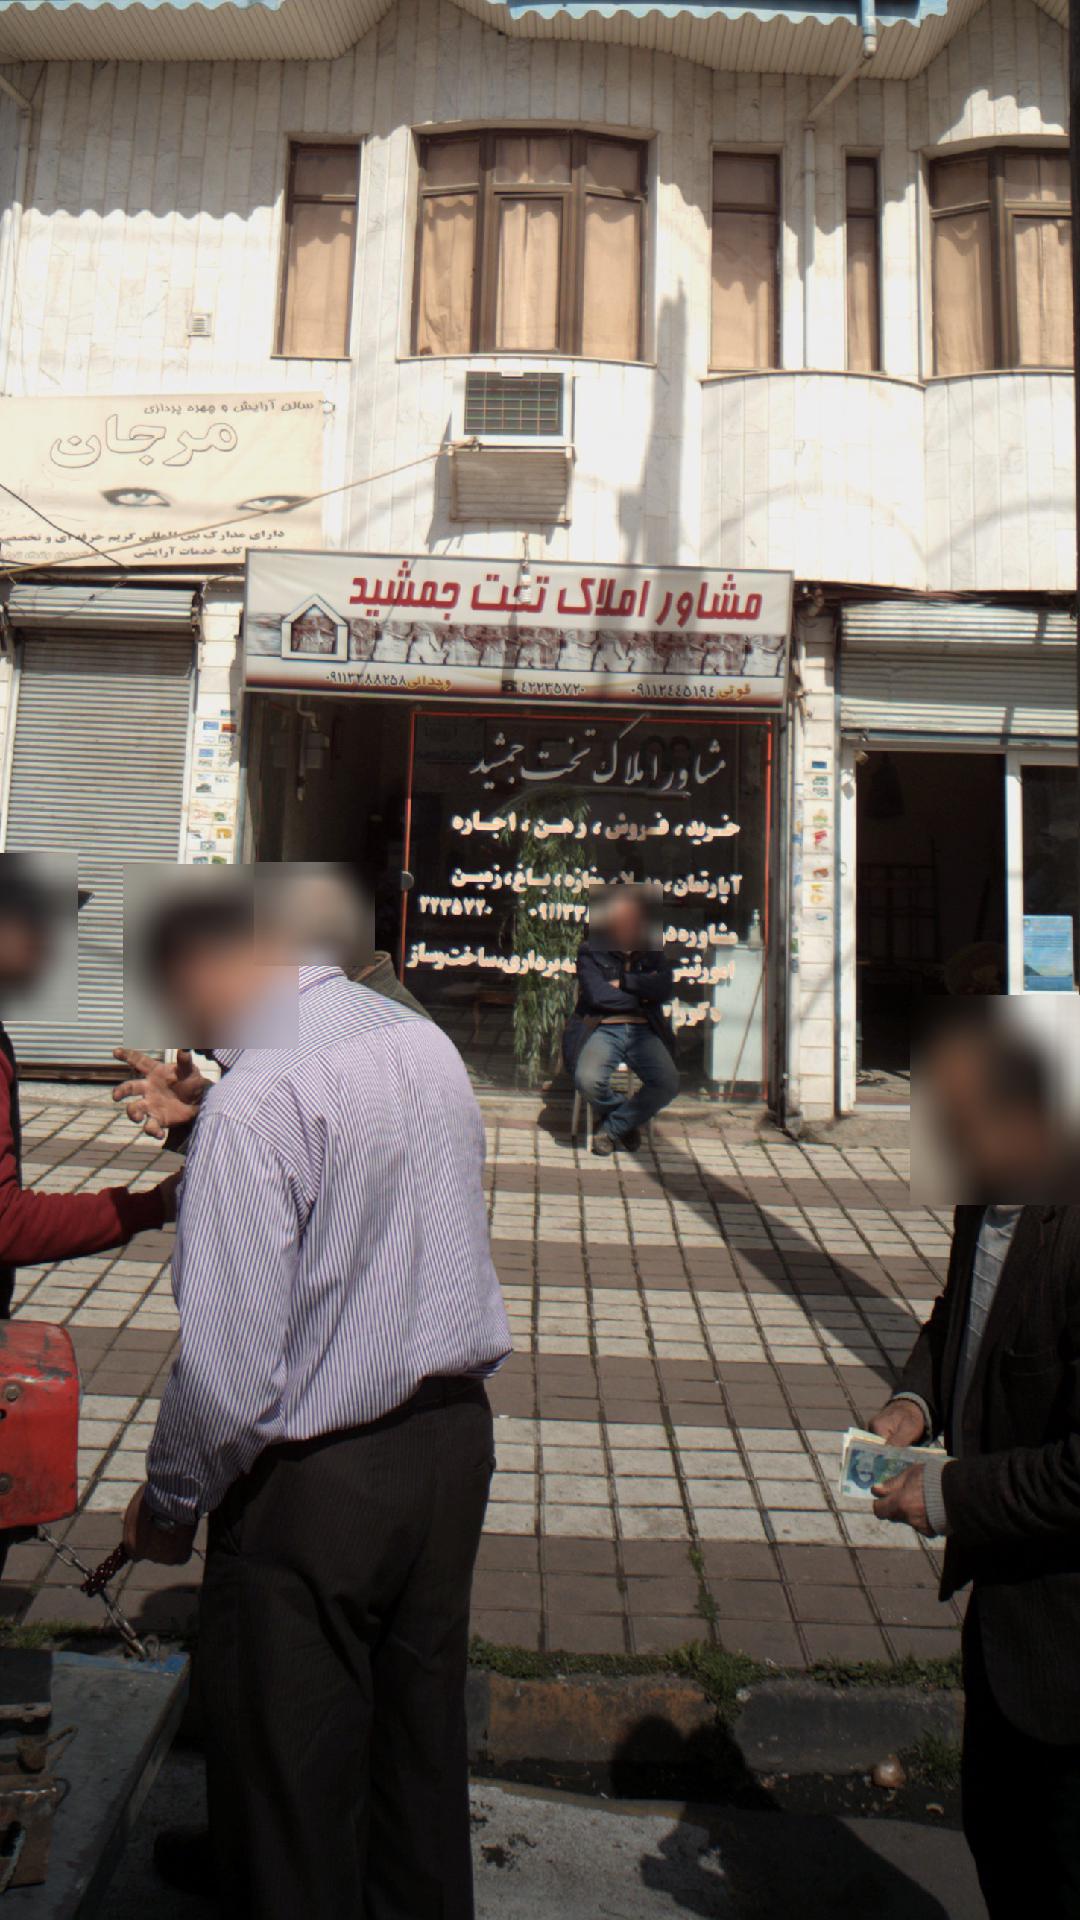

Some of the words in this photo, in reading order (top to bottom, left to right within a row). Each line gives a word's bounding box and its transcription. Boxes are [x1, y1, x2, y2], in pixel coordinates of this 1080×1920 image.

[233, 399, 276, 413] آرایش
[49, 413, 238, 469] مرجان
[179, 546, 218, 556] خدمات
[203, 530, 245, 541] مدارک
[249, 529, 285, 541] دارای
[349, 560, 461, 621] جمشید
[557, 577, 651, 617] املاک
[655, 574, 763, 627] مشاور
[469, 731, 526, 790] جمشید
[592, 715, 660, 785] املاک
[660, 738, 727, 792] مشاور
[451, 809, 517, 840] اجاره
